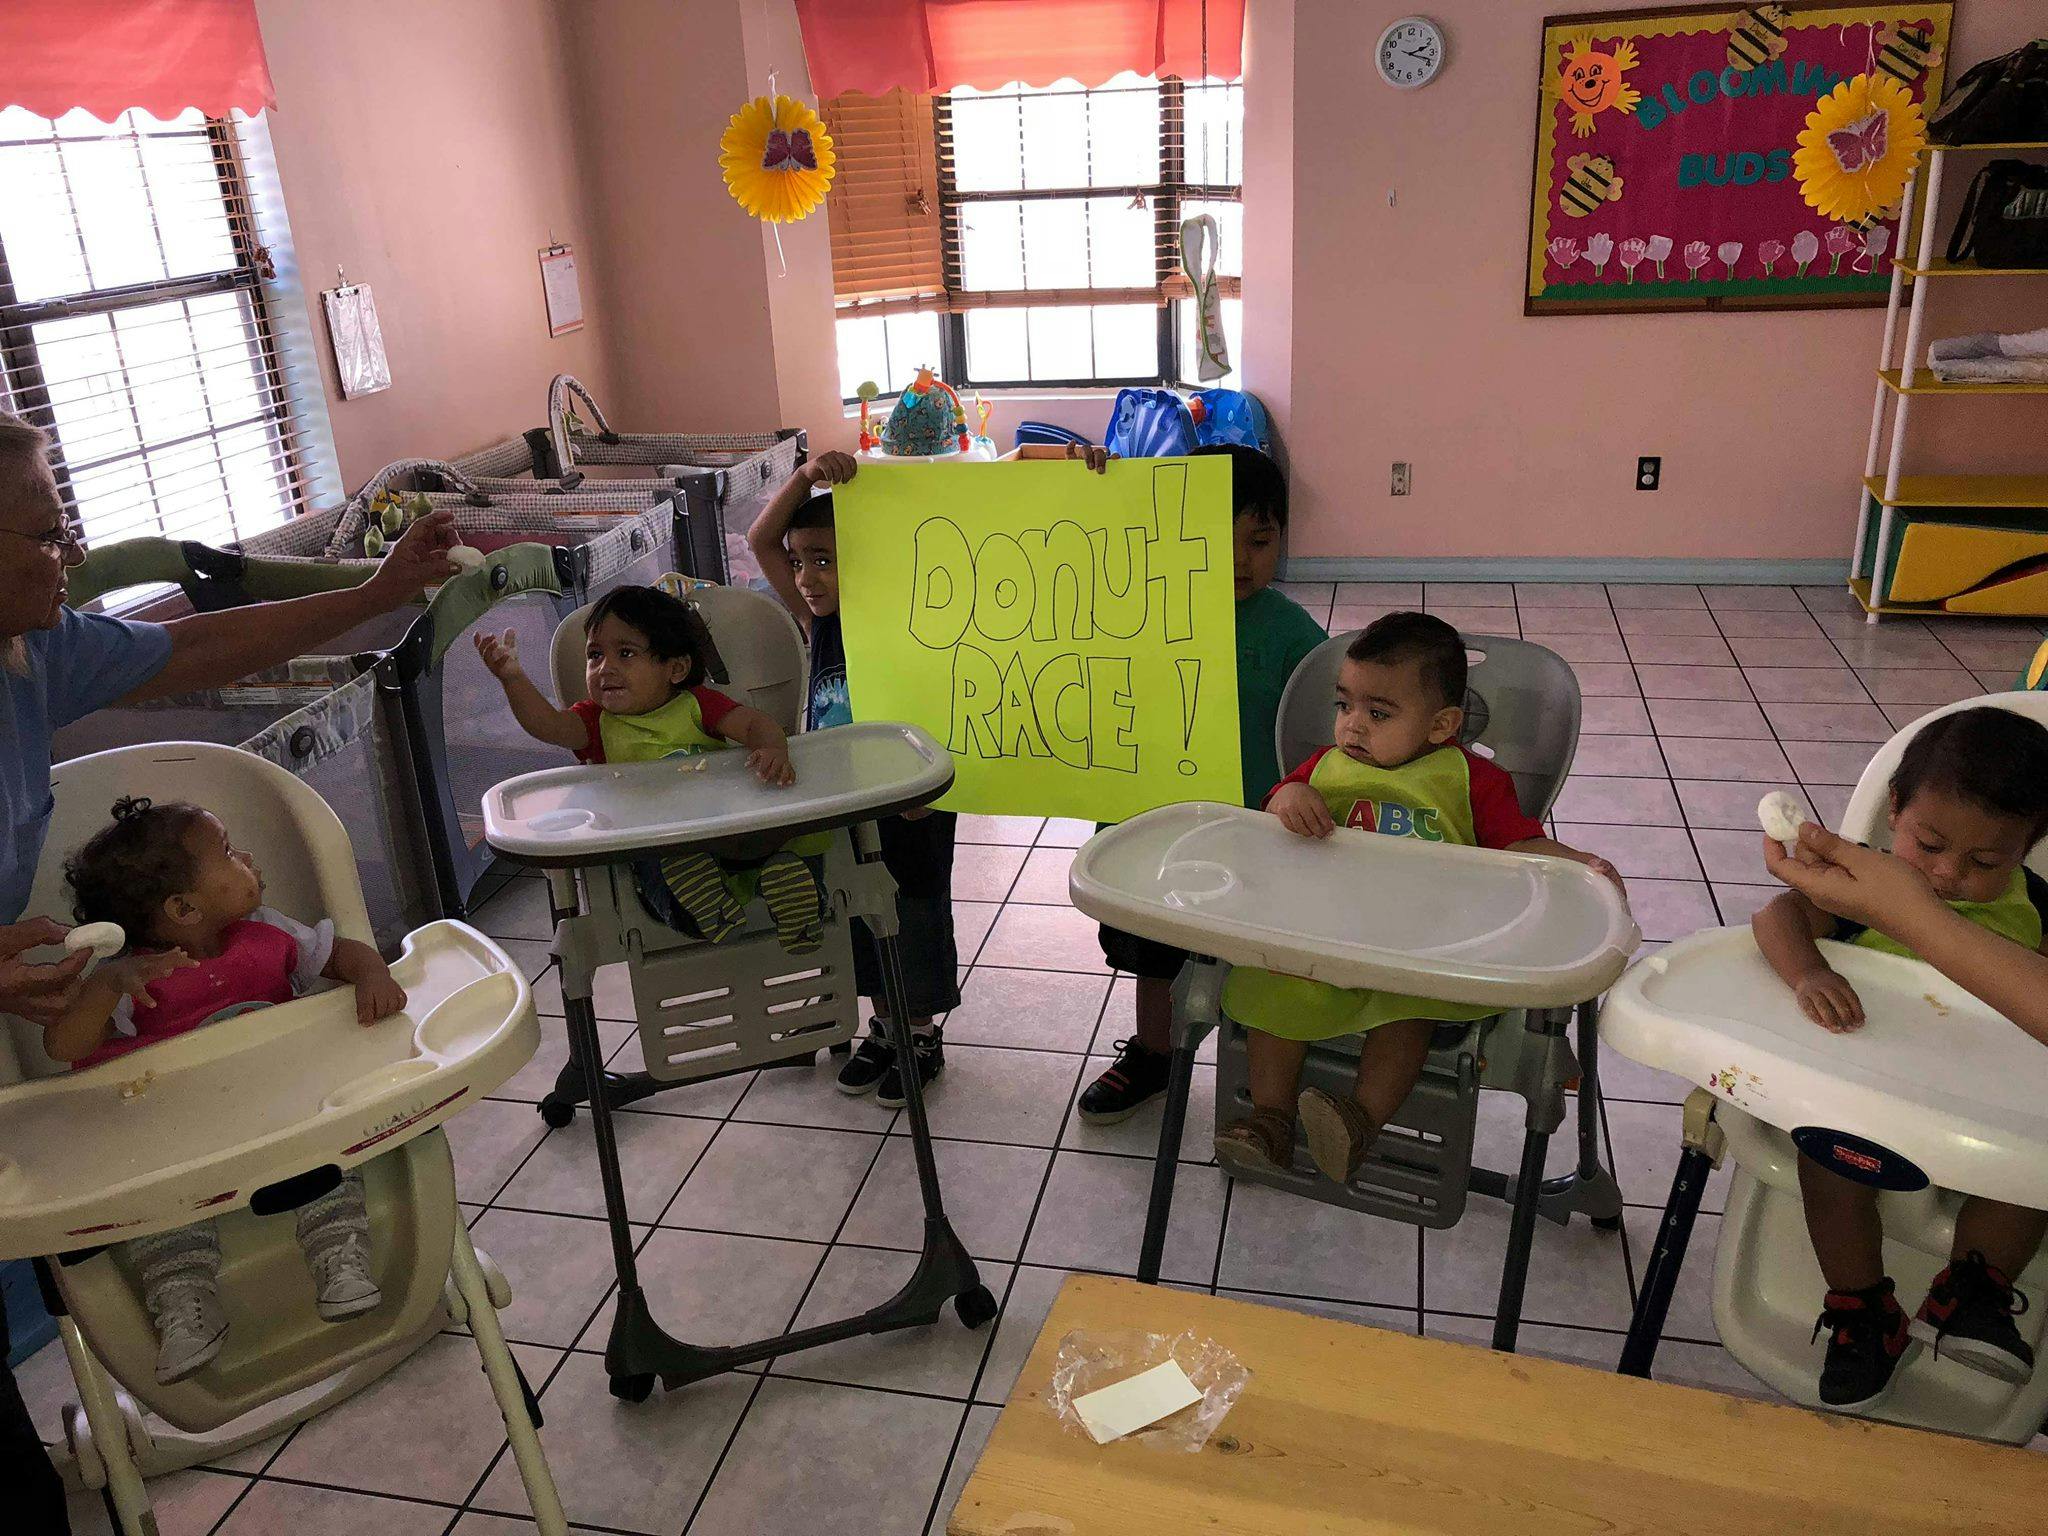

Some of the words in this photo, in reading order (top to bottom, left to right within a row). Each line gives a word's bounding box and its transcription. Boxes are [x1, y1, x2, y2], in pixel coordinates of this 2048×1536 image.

[1407, 27, 1416, 36] 12
[1389, 40, 1397, 48] 10
[1635, 58, 1853, 130] BLOOMIN
[1677, 149, 1791, 189] BUDS
[1345, 798, 1444, 842] ABC
[1679, 1180, 1688, 1192] 5
[1669, 1215, 1677, 1226] 6
[1661, 1247, 1669, 1259] 7
